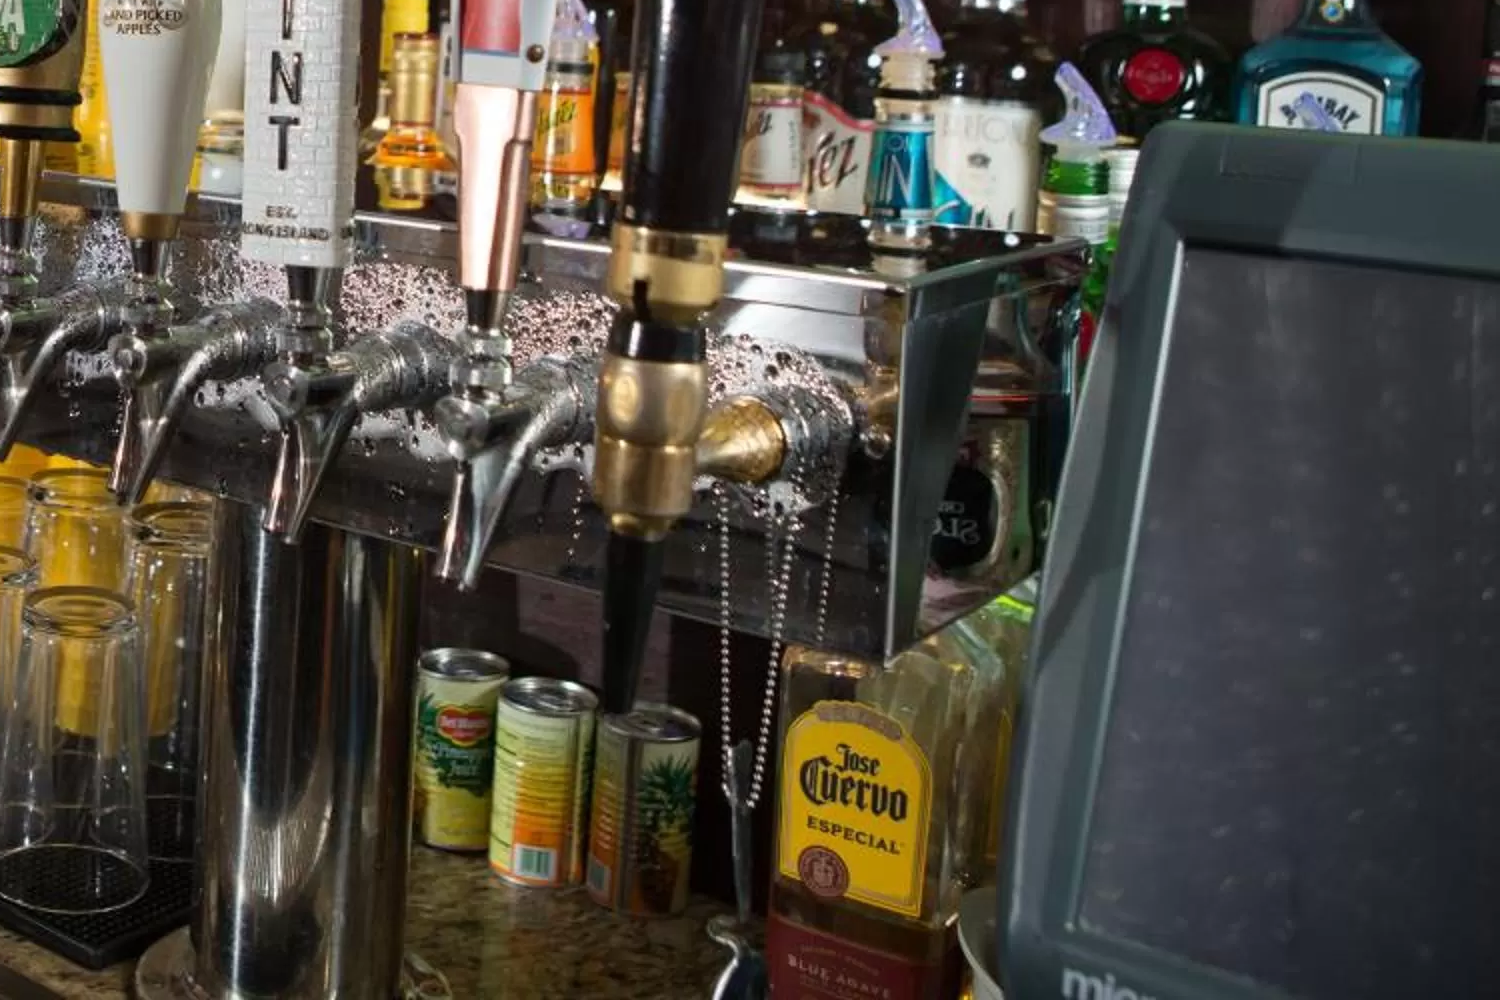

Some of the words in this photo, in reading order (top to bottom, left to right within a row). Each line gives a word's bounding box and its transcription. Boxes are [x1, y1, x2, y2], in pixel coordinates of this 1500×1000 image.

[116, 23, 161, 35] APPLES
[836, 743, 880, 777] Jose
[800, 755, 908, 822] Cuervo
[806, 815, 900, 855] ESPECIAL
